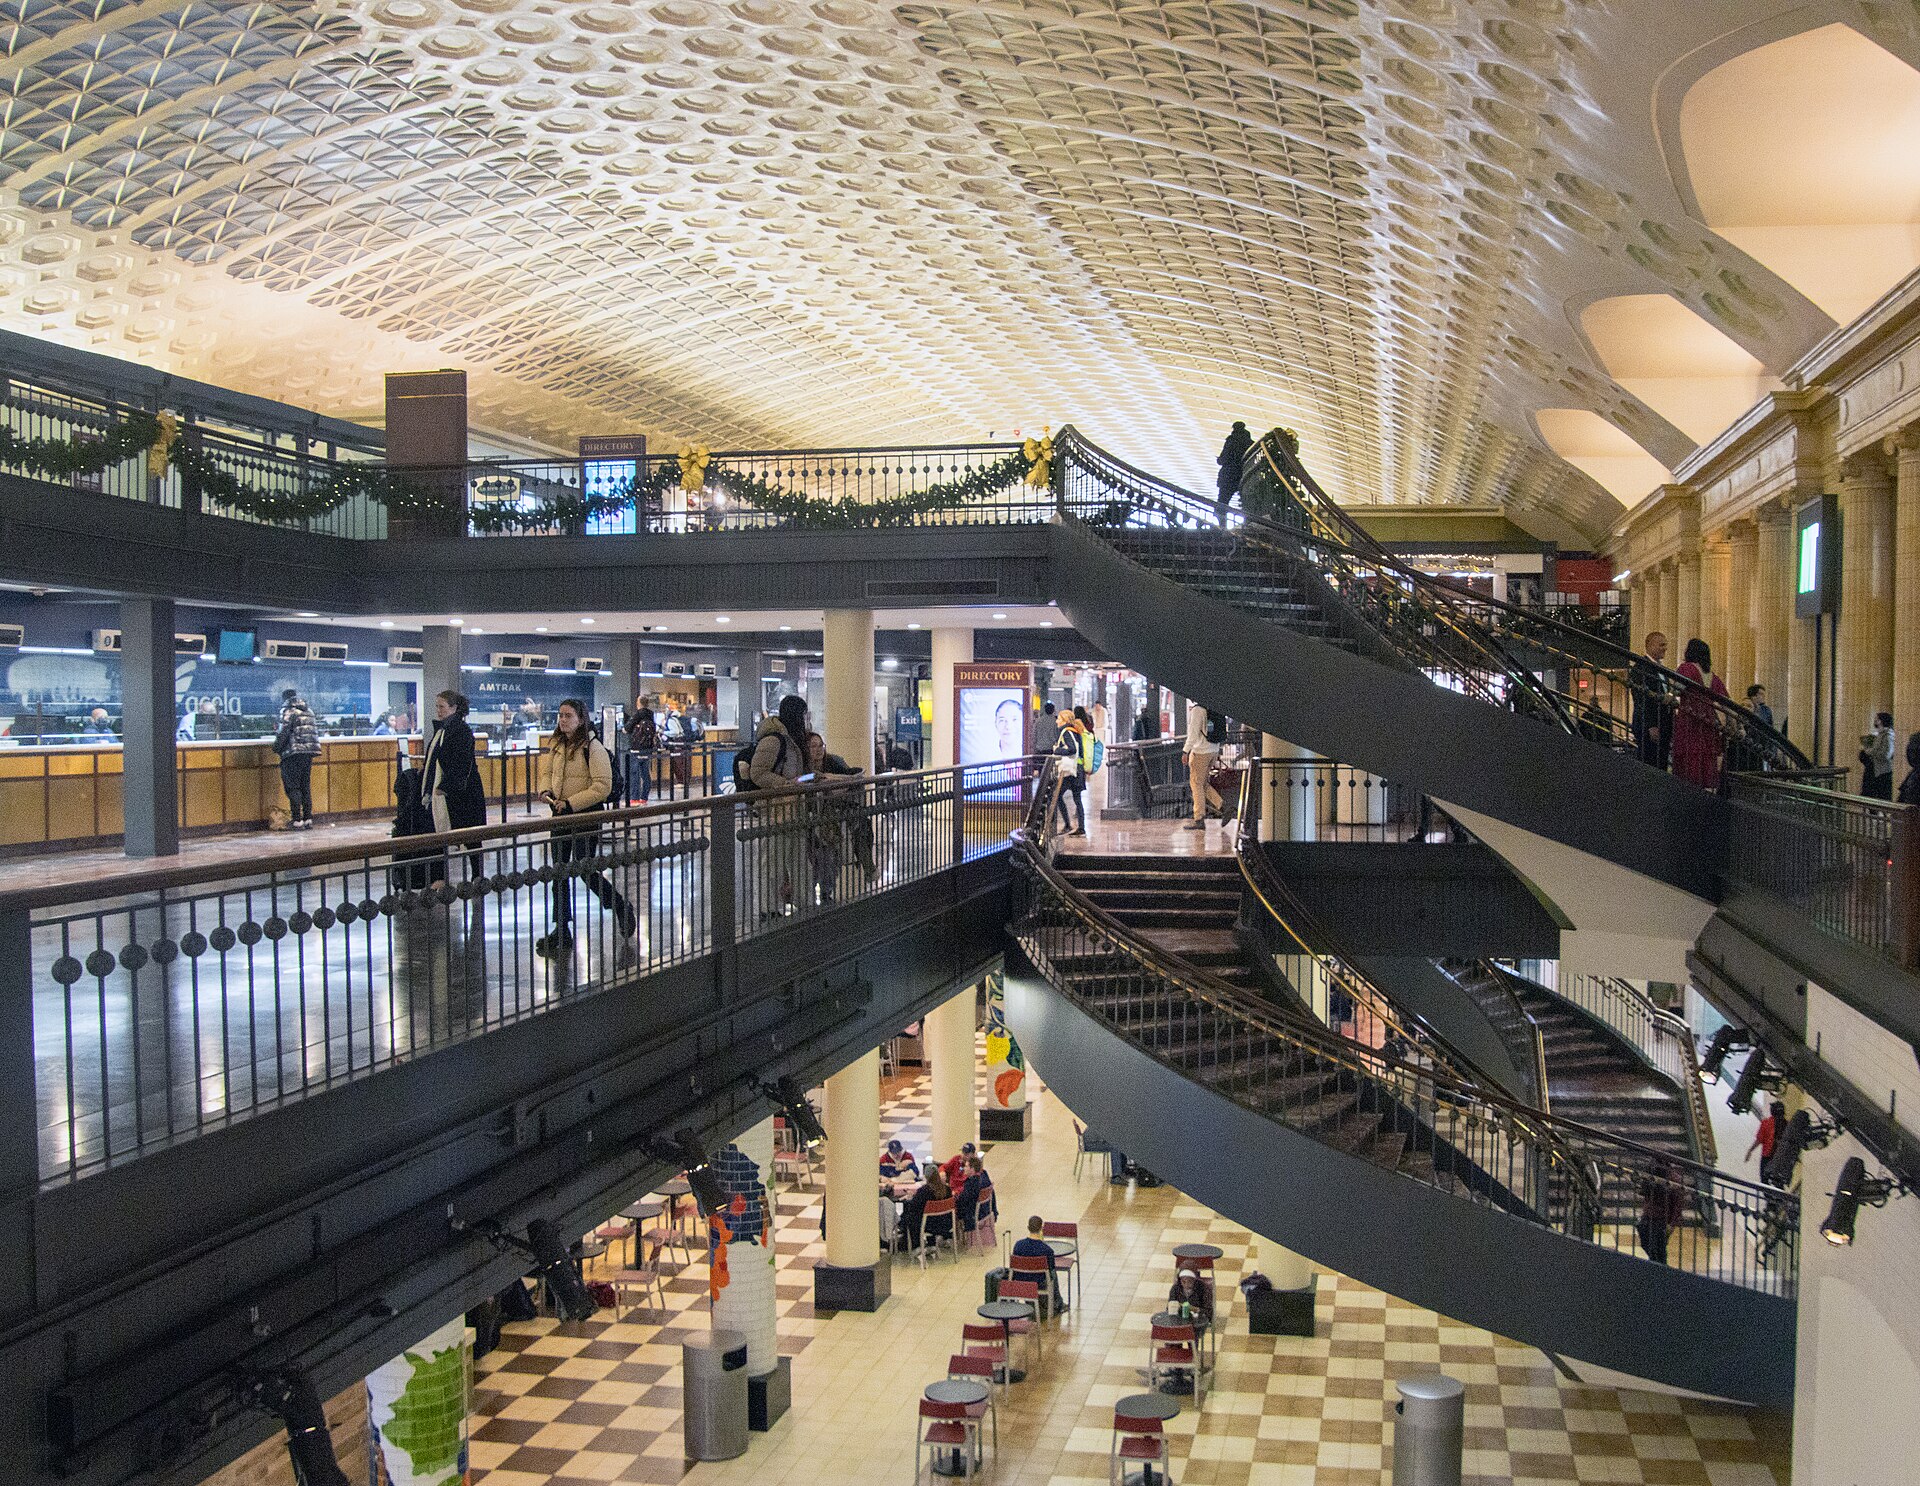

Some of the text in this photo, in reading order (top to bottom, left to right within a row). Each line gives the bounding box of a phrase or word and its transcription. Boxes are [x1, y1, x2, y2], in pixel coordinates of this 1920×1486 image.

[584, 442, 634, 451] DIRECTORY
[960, 671, 1023, 681] DIRECTORY
[479, 683, 522, 692] AMTRAK
[900, 716, 917, 725] Exit
